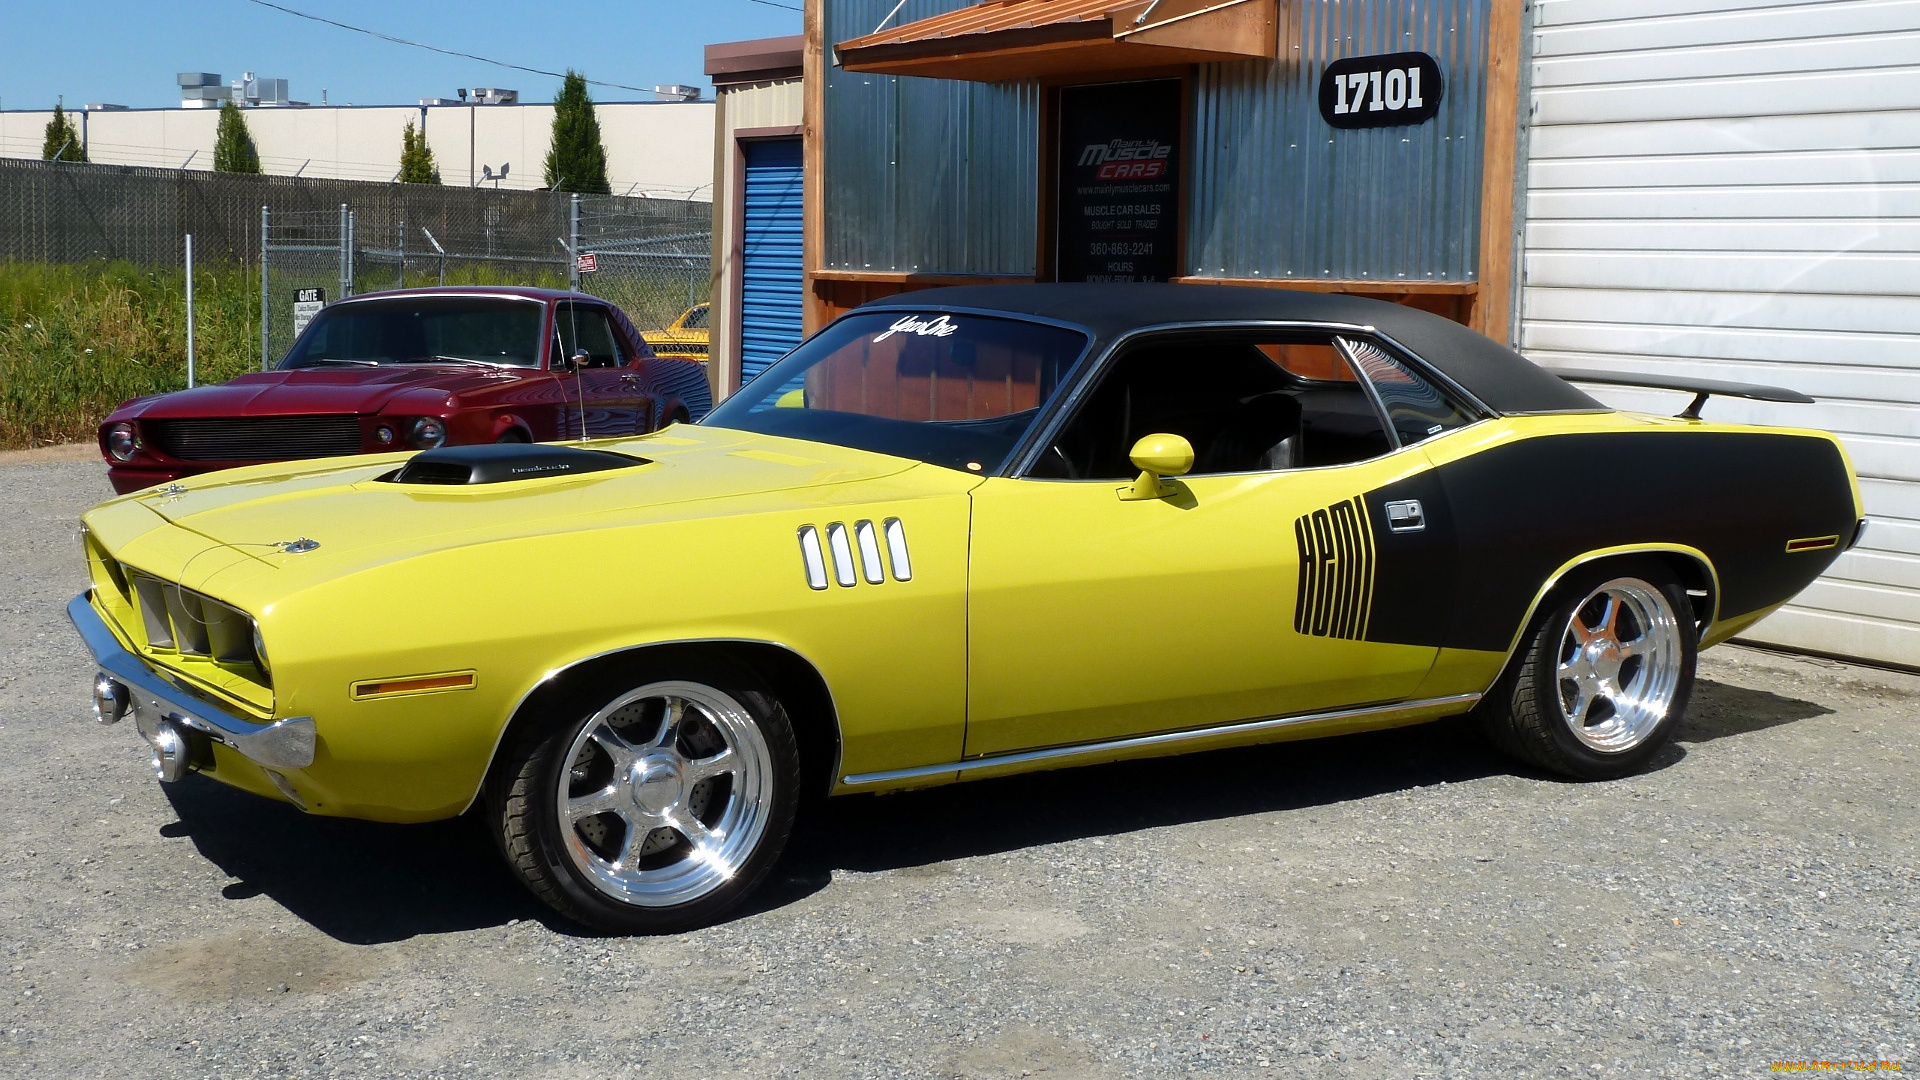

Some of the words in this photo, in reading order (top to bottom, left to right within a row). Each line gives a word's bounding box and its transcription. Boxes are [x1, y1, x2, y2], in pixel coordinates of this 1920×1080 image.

[1334, 67, 1423, 114] 17101
[1100, 162, 1162, 178] CARS
[1077, 183, 1170, 196] www.mainlymusclecars.com
[1084, 205, 1116, 216] MUSCLE
[1116, 205, 1134, 215] CAR
[1134, 204, 1161, 215] SALES
[1091, 220, 1115, 230] BOUGHT
[1116, 220, 1132, 229] SOLD
[1135, 219, 1158, 229] TRADED
[1090, 242, 1153, 255] 360-863-2241
[1107, 262, 1134, 273] HOURS
[299, 289, 318, 301] GATE
